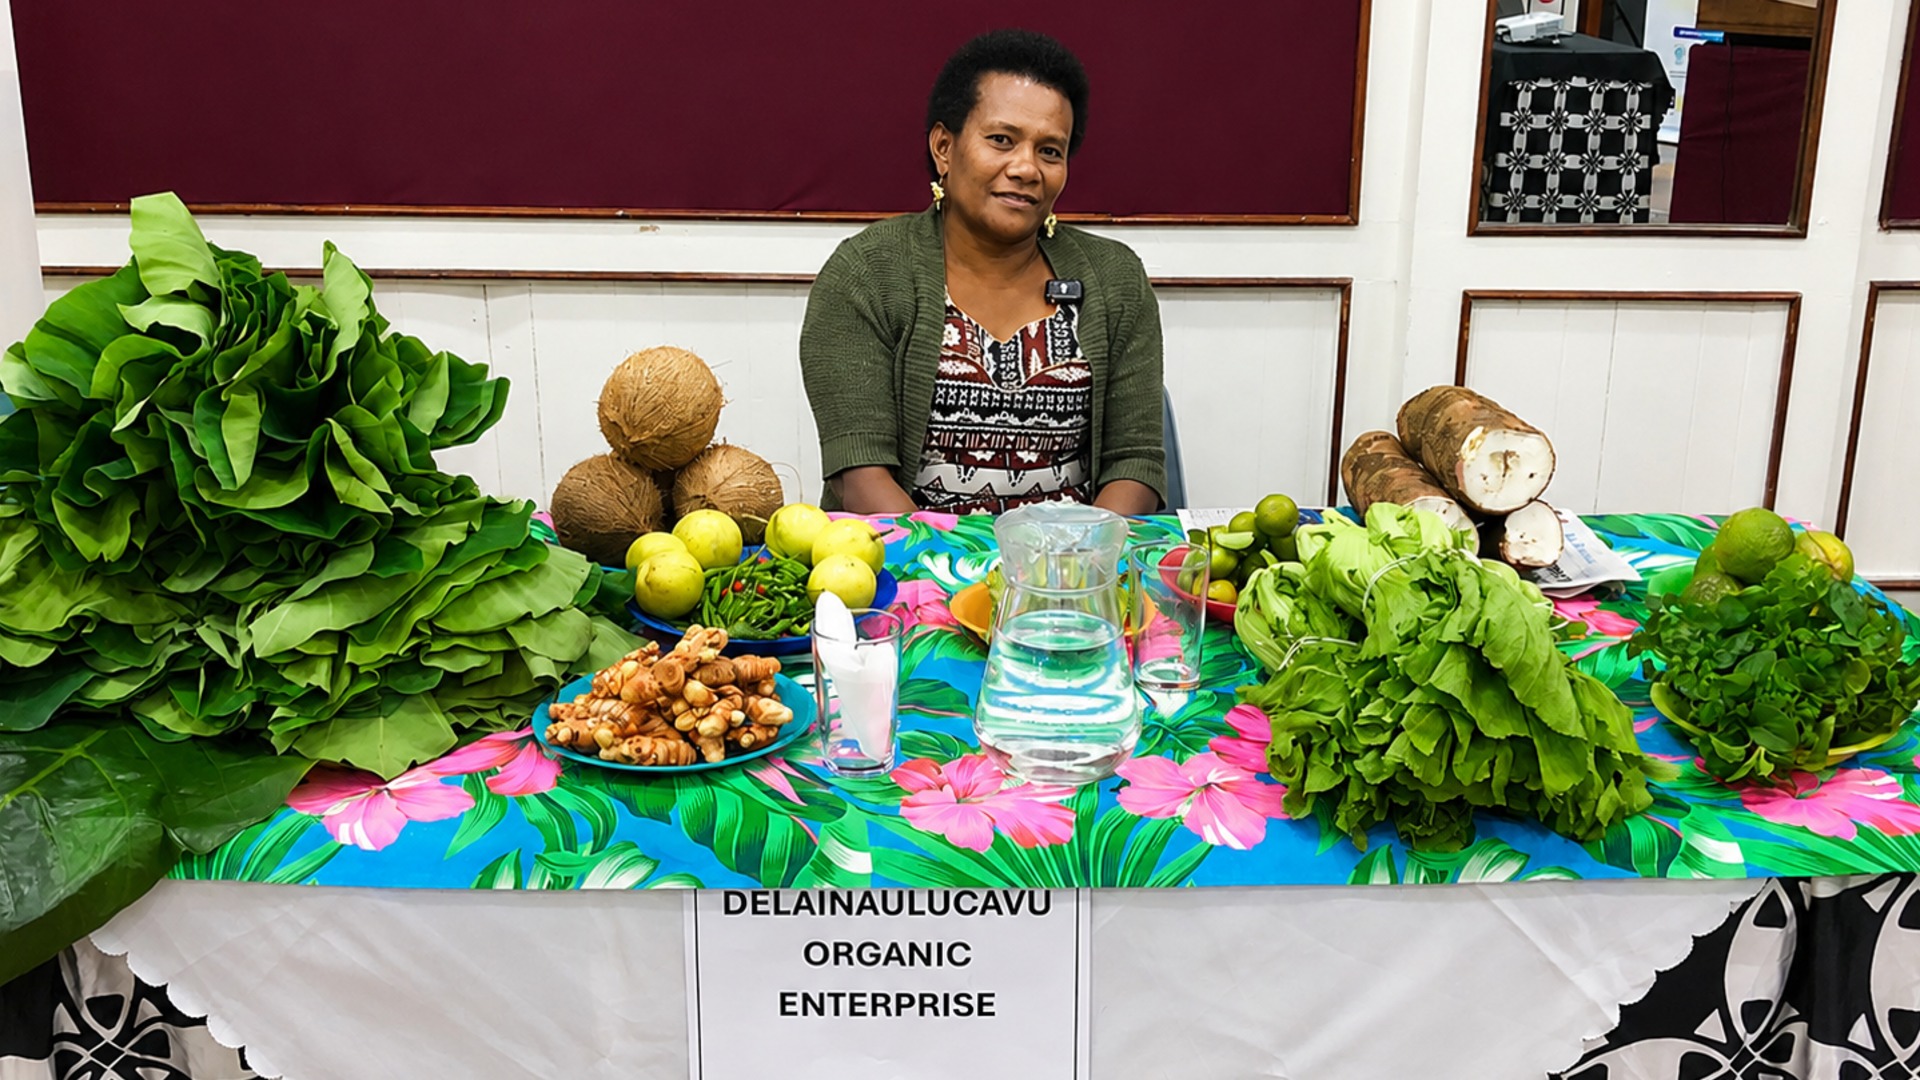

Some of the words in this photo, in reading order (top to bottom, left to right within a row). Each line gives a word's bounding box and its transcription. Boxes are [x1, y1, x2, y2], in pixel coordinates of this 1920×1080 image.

[723, 890, 1051, 916] DELAINAULUCAVU
[803, 941, 972, 967] ORGANIC
[779, 992, 997, 1017] ENTERPRISE
